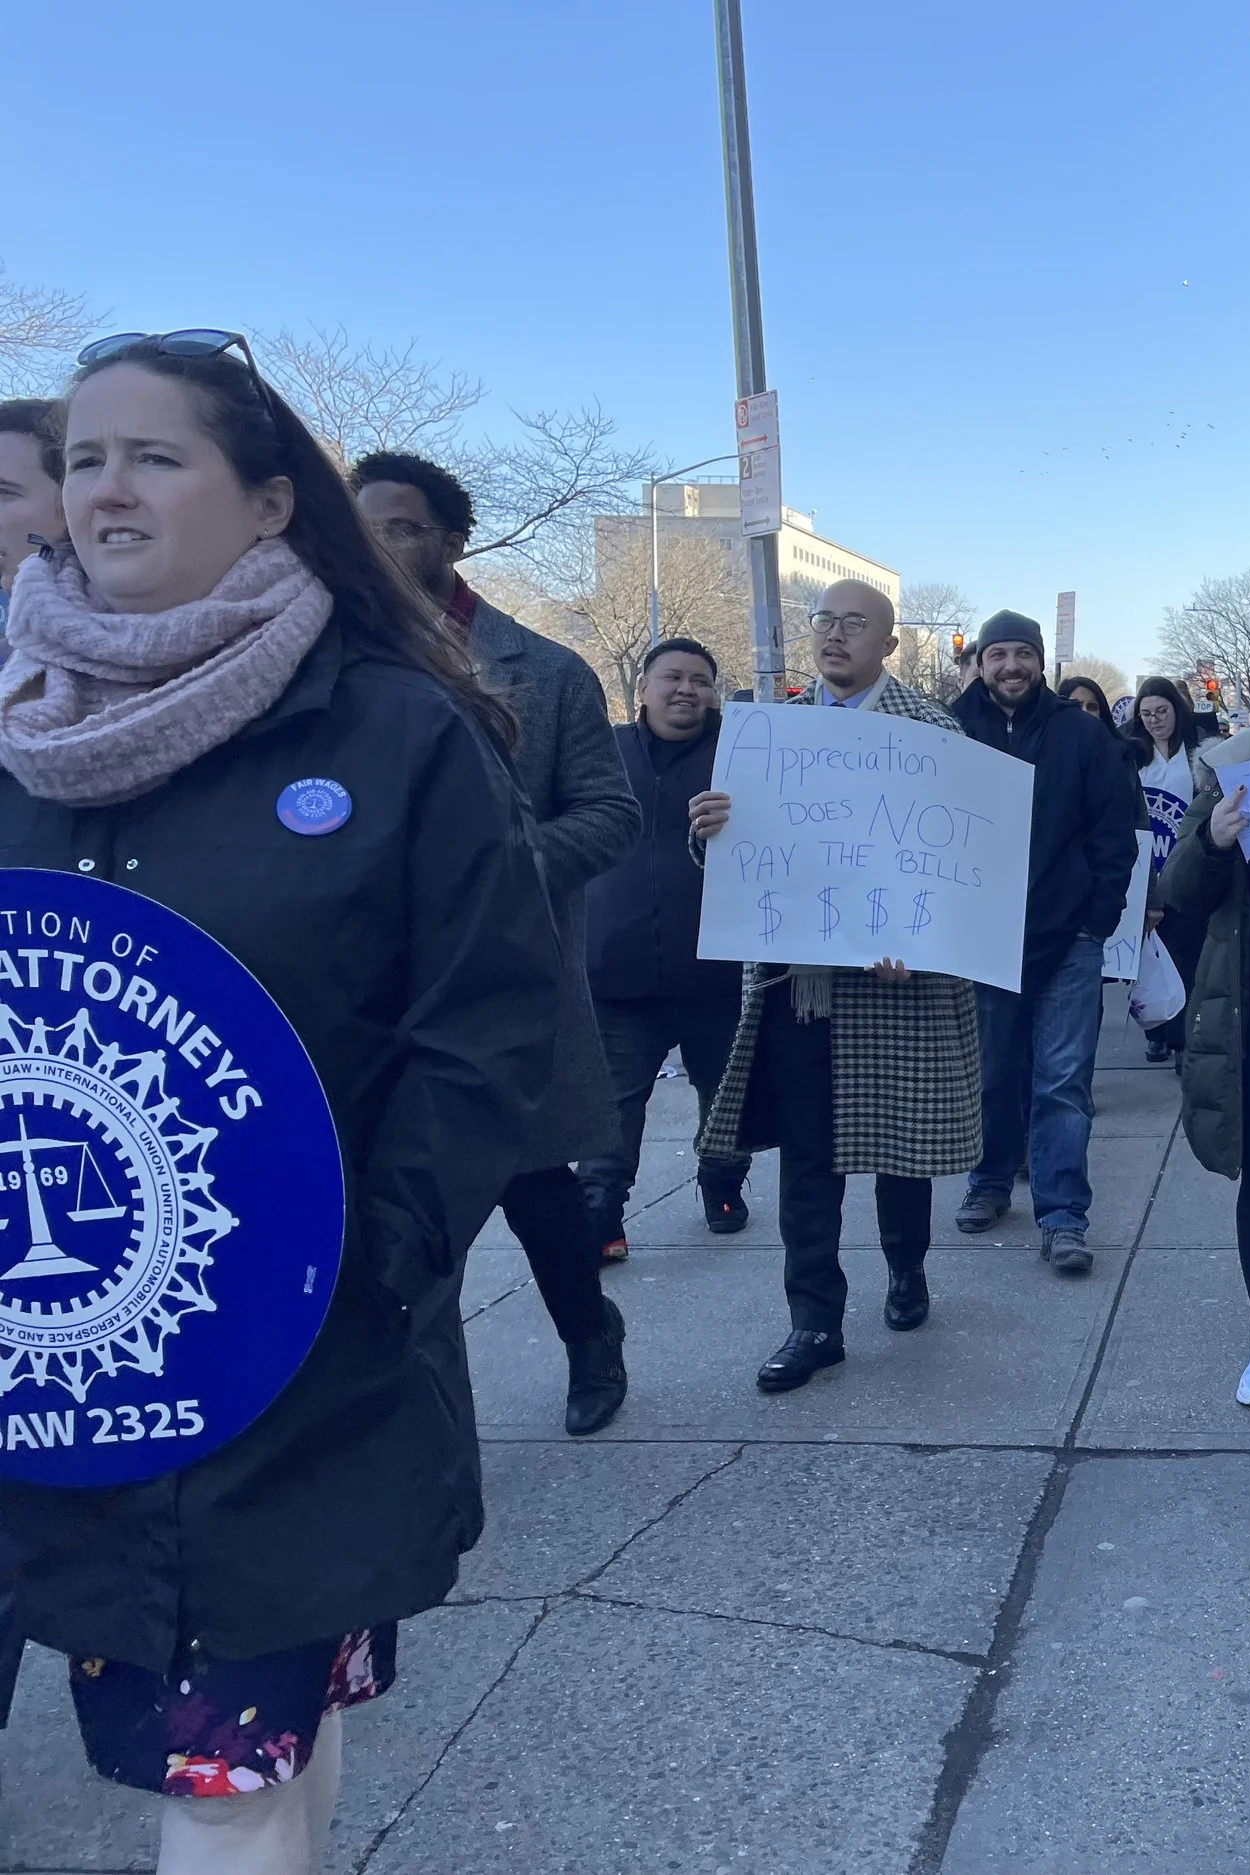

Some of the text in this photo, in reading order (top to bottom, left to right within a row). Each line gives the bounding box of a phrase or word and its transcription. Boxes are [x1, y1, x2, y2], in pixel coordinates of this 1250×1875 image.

[1196, 702, 1211, 711] TOP
[290, 778, 346, 798] FAIR WAGES
[778, 793, 995, 849] DOES NOT
[731, 841, 984, 888] PAY THE BILLS
[0, 910, 159, 967] TION OF
[758, 886, 936, 946] $ $ $ $
[0, 948, 263, 1120] ATTORNEYS
[2, 1062, 174, 1343] UAW INTERNATIONAL UNION UNITED AUTOMOBILE AEROSPACE AND
[0, 1399, 205, 1451] AW 2325
